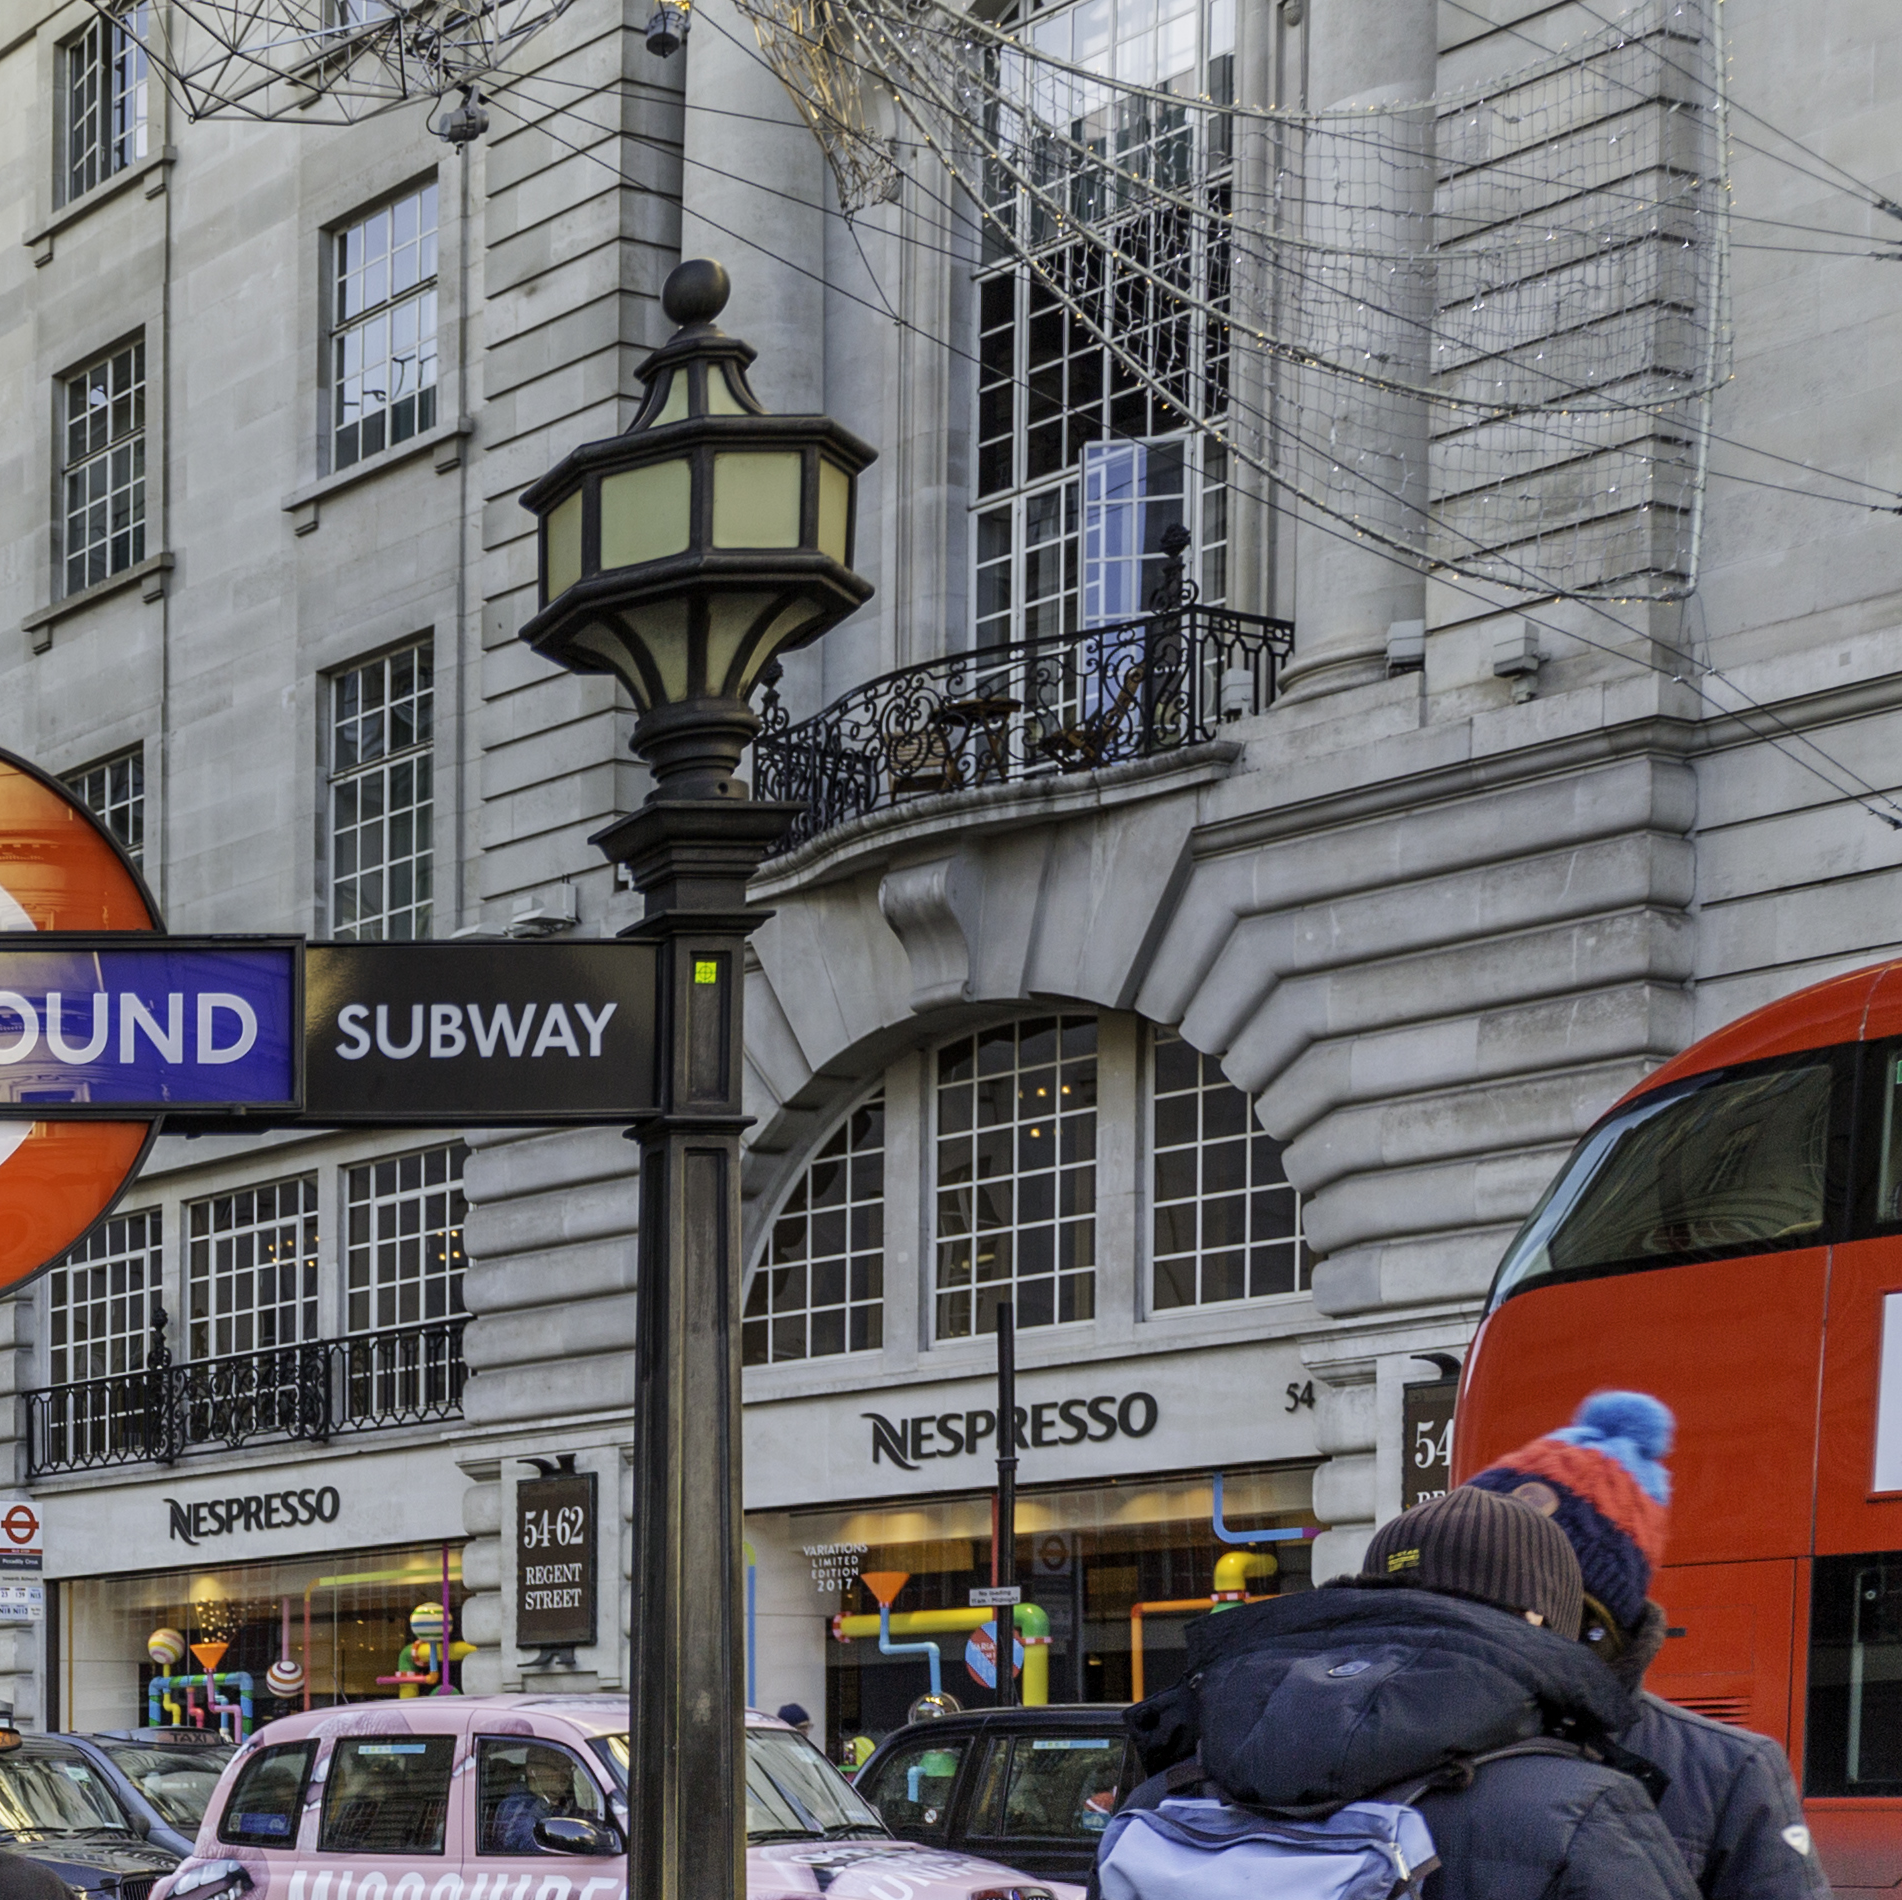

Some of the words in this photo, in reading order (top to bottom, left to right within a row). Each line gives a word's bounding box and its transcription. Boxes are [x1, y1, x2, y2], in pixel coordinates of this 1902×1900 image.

[336, 1003, 618, 1060] SUBWAY
[1284, 1380, 1315, 1412] 54
[860, 1391, 1159, 1470] NESPRESSO
[1414, 1418, 1454, 1469] 54
[162, 1485, 341, 1546] NESPRESSO
[523, 1506, 584, 1549] 54-62
[802, 1542, 869, 1556] VARIATIONS
[811, 1555, 859, 1568] LIMITED
[811, 1567, 859, 1579] EDITION
[525, 1563, 583, 1586] REGENT
[817, 1578, 853, 1592] 2017
[524, 1588, 583, 1611] STREET
[170, 1732, 208, 1743] TAXI
